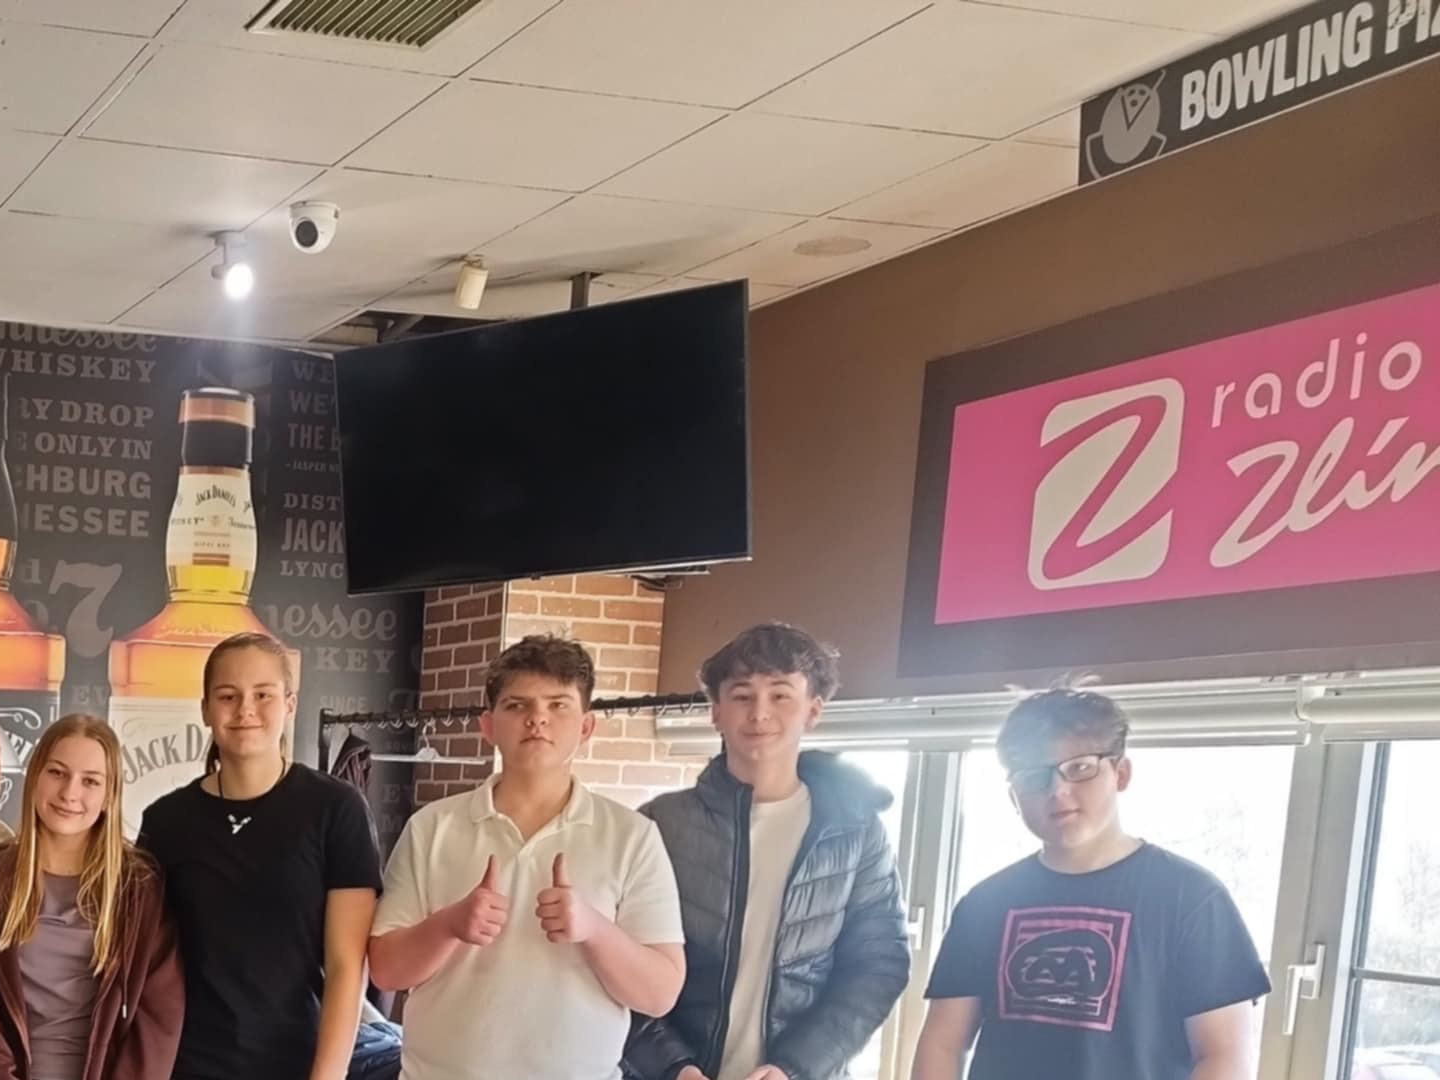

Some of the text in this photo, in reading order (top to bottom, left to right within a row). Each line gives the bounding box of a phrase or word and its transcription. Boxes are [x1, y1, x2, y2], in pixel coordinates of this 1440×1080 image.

[1179, 2, 1374, 131] BOWLING
[1210, 331, 1423, 429] radio
[60, 399, 155, 429] DROP
[34, 431, 117, 459] ONLY
[120, 438, 153, 461] IN
[288, 422, 325, 450] THE
[25, 463, 153, 501] HBURG
[24, 502, 151, 538] ESSEE
[280, 517, 345, 554] JACK
[48, 559, 124, 658] 7
[120, 734, 182, 785] JACK
